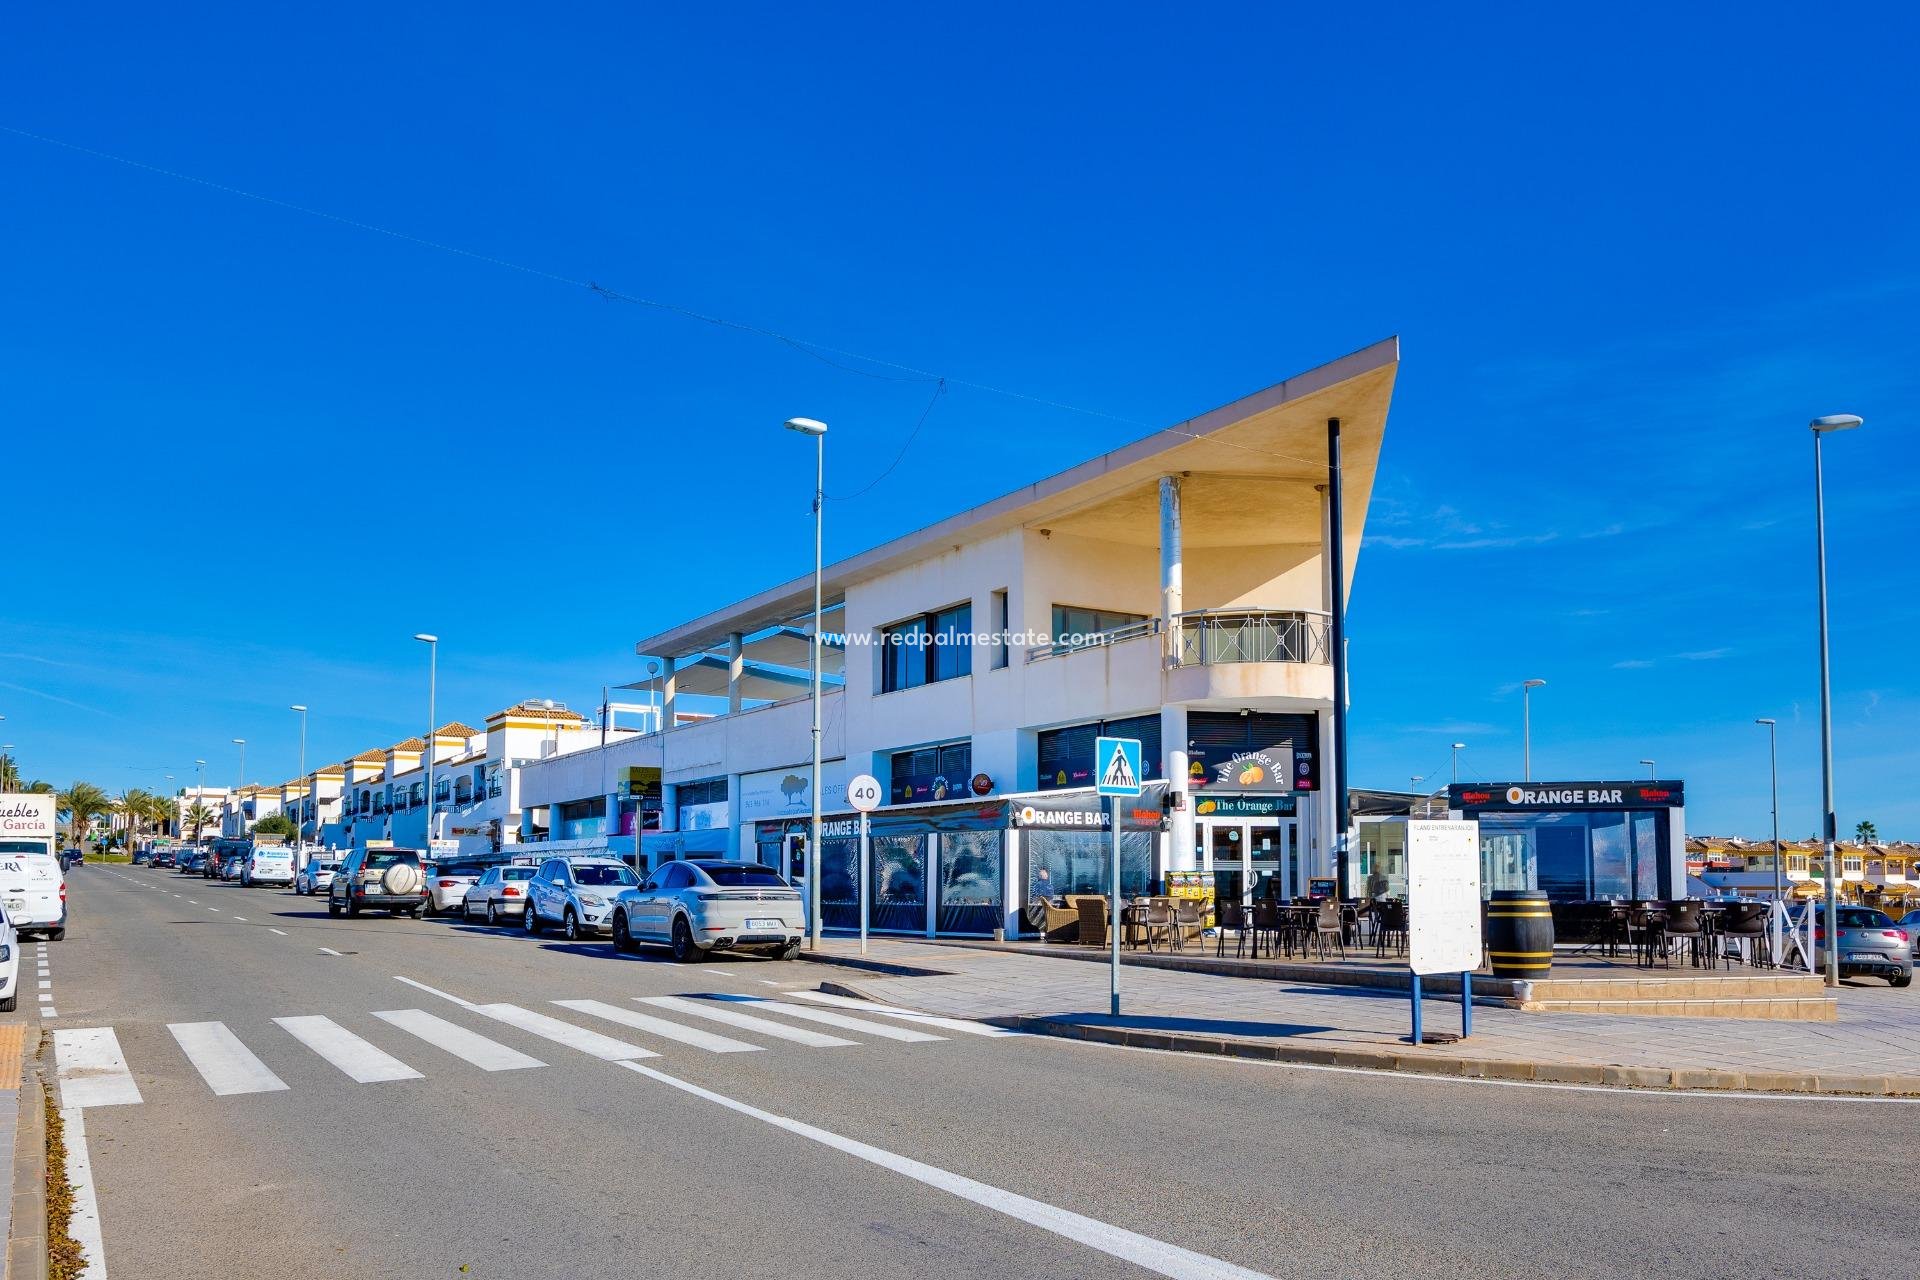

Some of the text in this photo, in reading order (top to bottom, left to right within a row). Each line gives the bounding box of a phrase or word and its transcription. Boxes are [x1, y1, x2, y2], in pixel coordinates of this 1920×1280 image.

[1217, 762, 1234, 784] The
[1231, 751, 1272, 766] Orange
[1270, 762, 1284, 785] Bar
[854, 787, 875, 800] 40
[1506, 786, 1623, 805] ORANGE BAR
[1216, 799, 1294, 813] The Orange Bar
[3, 818, 46, 830] García
[1021, 807, 1111, 825] ORANGE BAR
[820, 818, 872, 837] RANGE BR
